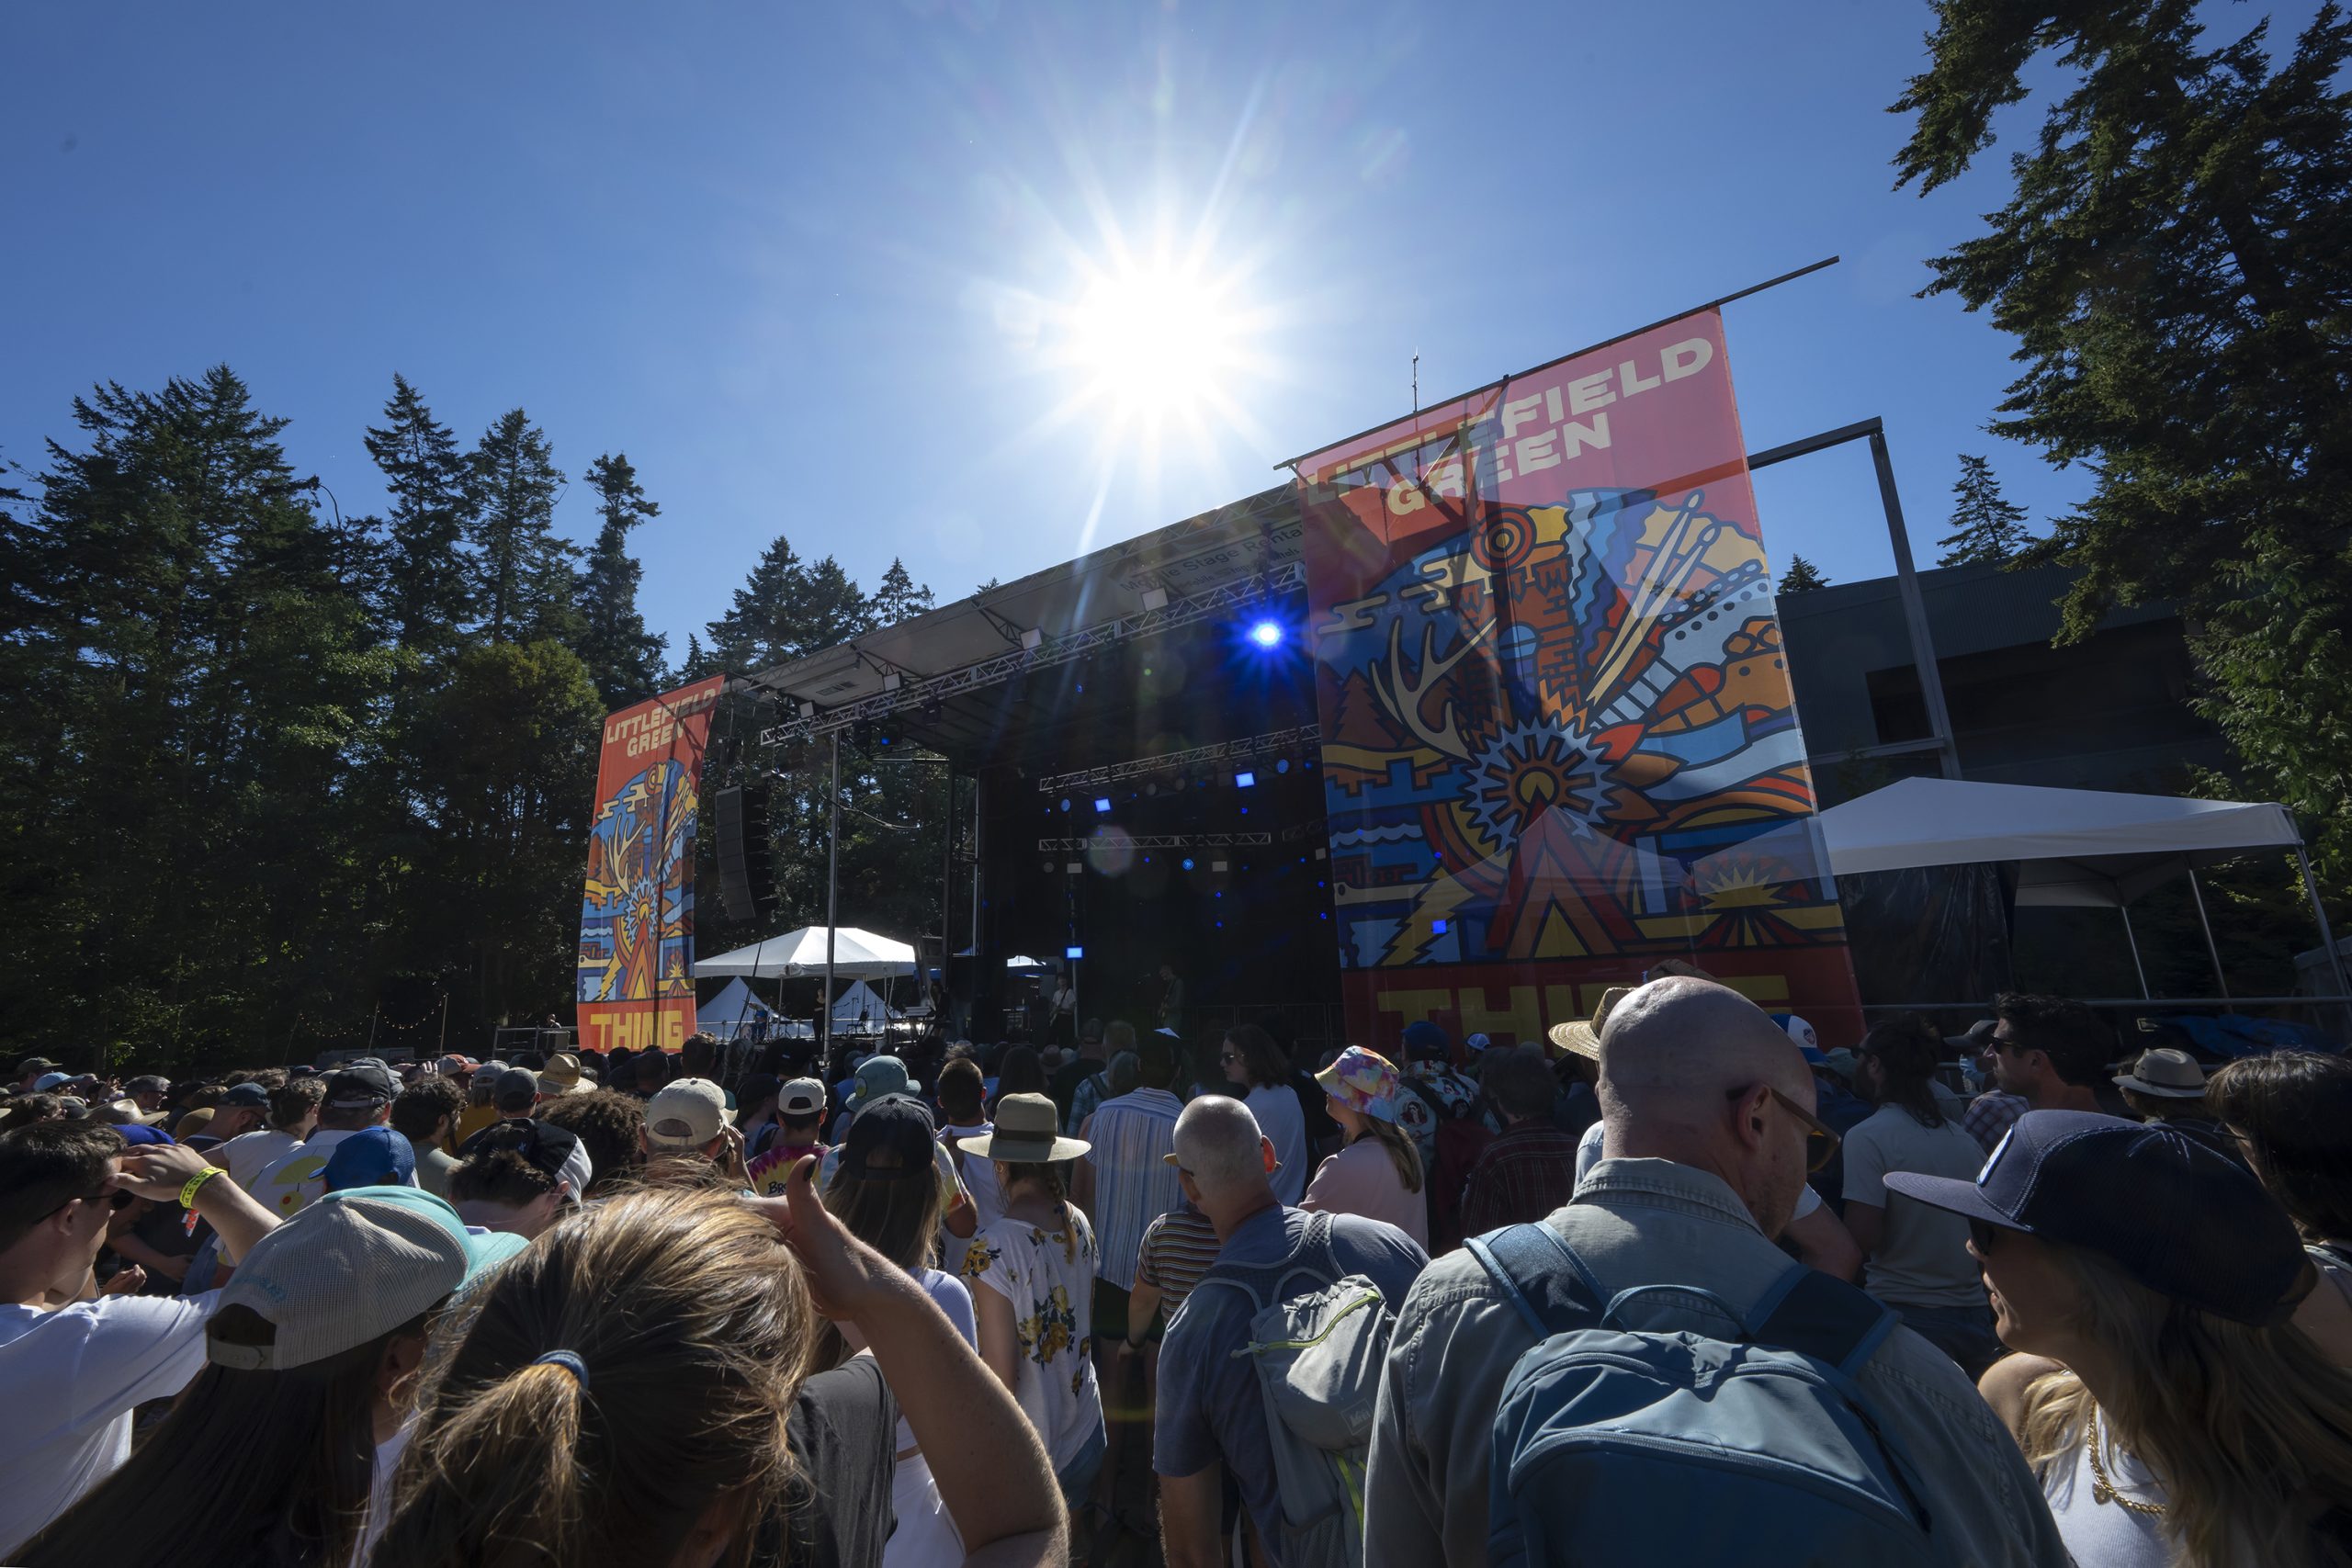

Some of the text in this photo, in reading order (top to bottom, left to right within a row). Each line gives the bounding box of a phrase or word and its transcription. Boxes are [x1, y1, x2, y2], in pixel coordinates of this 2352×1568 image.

[1387, 412, 1611, 515] GREEN
[1182, 549, 1240, 572] Stage
[606, 688, 716, 744] LITTLEFIELD
[627, 718, 685, 757] GREEN
[590, 1010, 684, 1049] THING
